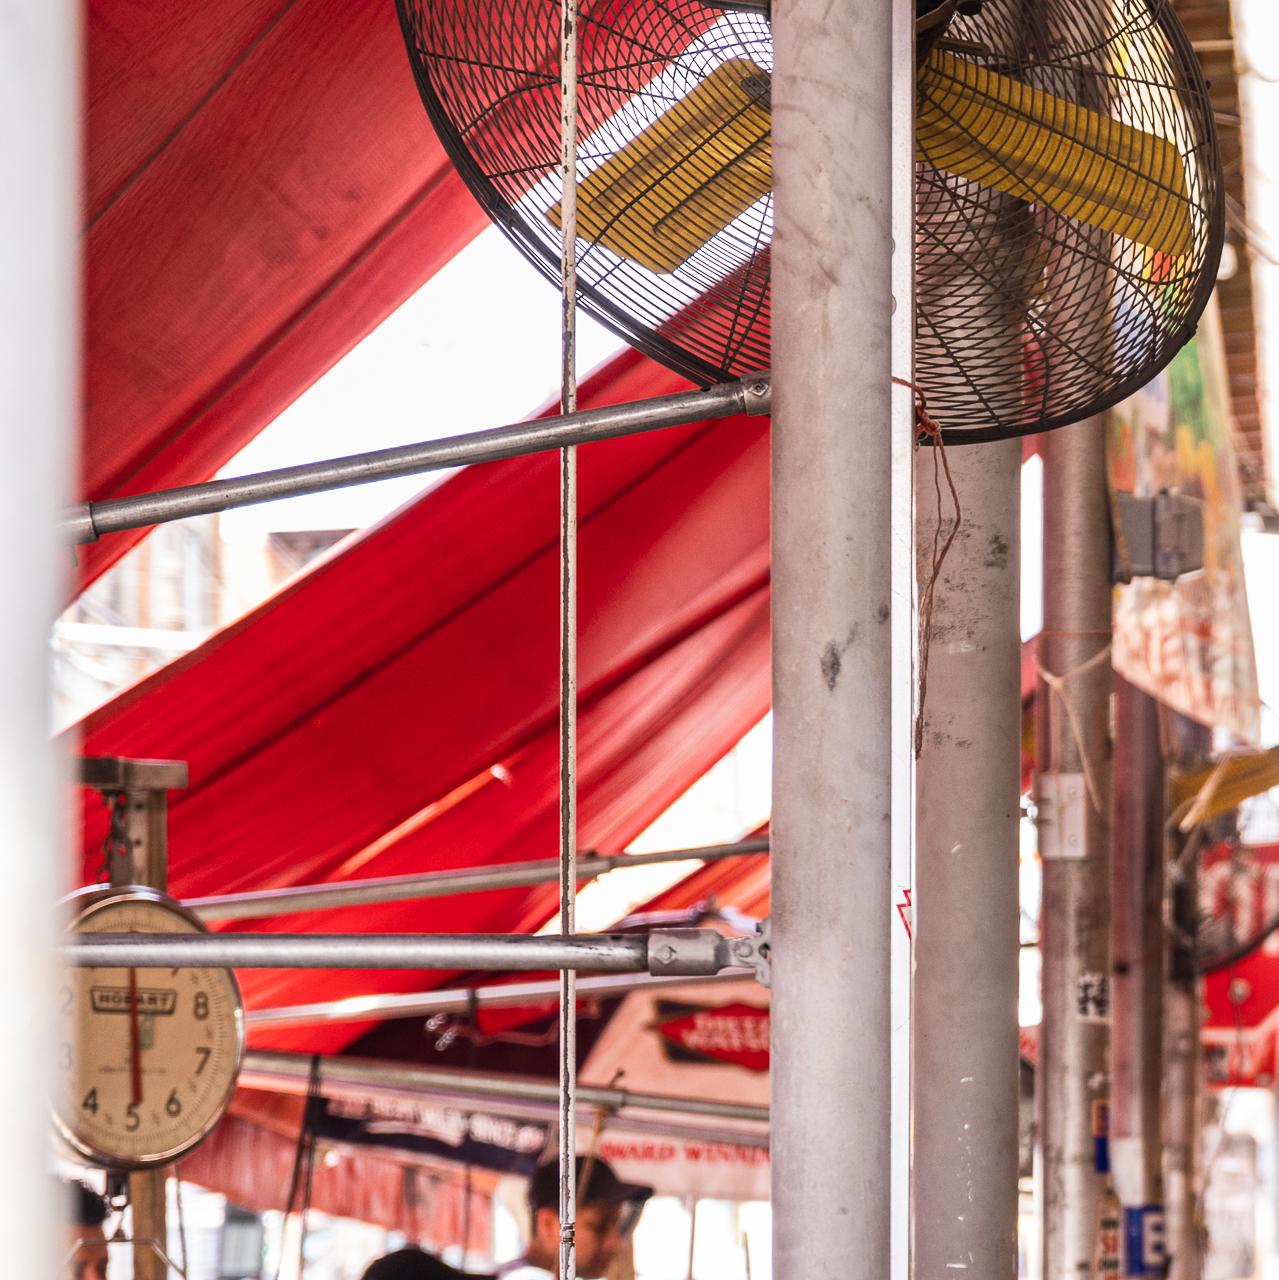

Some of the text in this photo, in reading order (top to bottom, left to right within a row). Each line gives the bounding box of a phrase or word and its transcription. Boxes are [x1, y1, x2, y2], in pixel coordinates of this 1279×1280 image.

[193, 991, 209, 1020] 8
[195, 1047, 211, 1076] 7
[82, 1087, 98, 1114] 4
[166, 1088, 181, 1117] 6
[125, 1103, 140, 1132] 5
